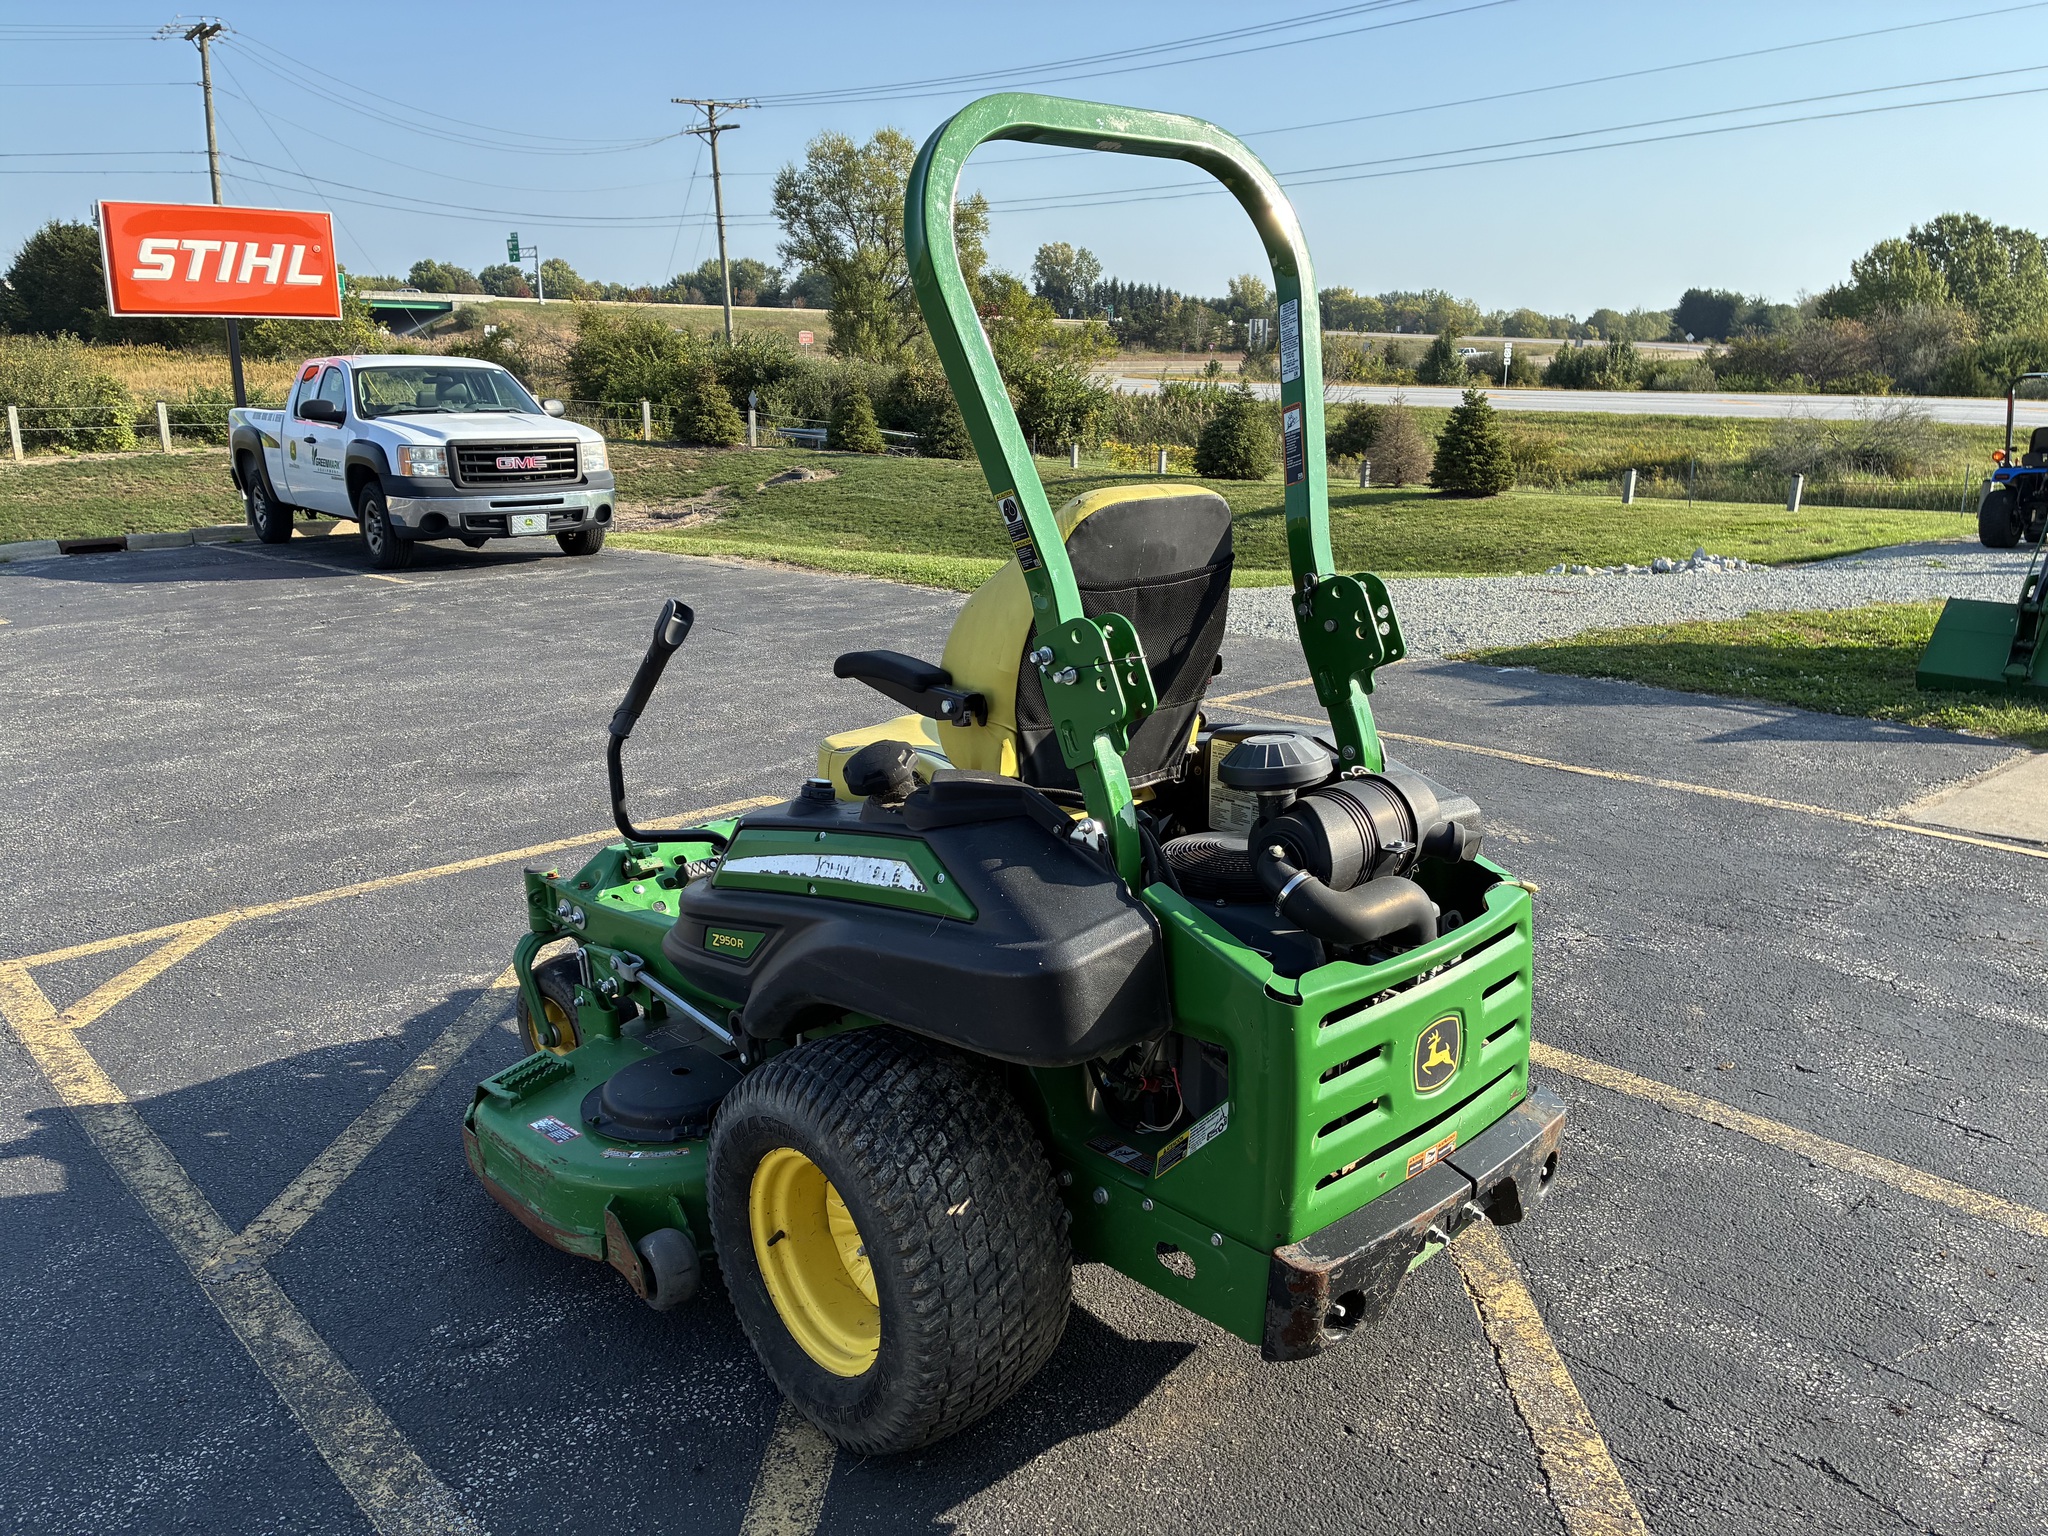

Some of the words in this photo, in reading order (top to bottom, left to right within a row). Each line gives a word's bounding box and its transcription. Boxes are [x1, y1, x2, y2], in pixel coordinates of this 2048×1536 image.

[131, 238, 323, 285] STIHL
[496, 455, 547, 469] GMC
[712, 933, 744, 949] Z950R
